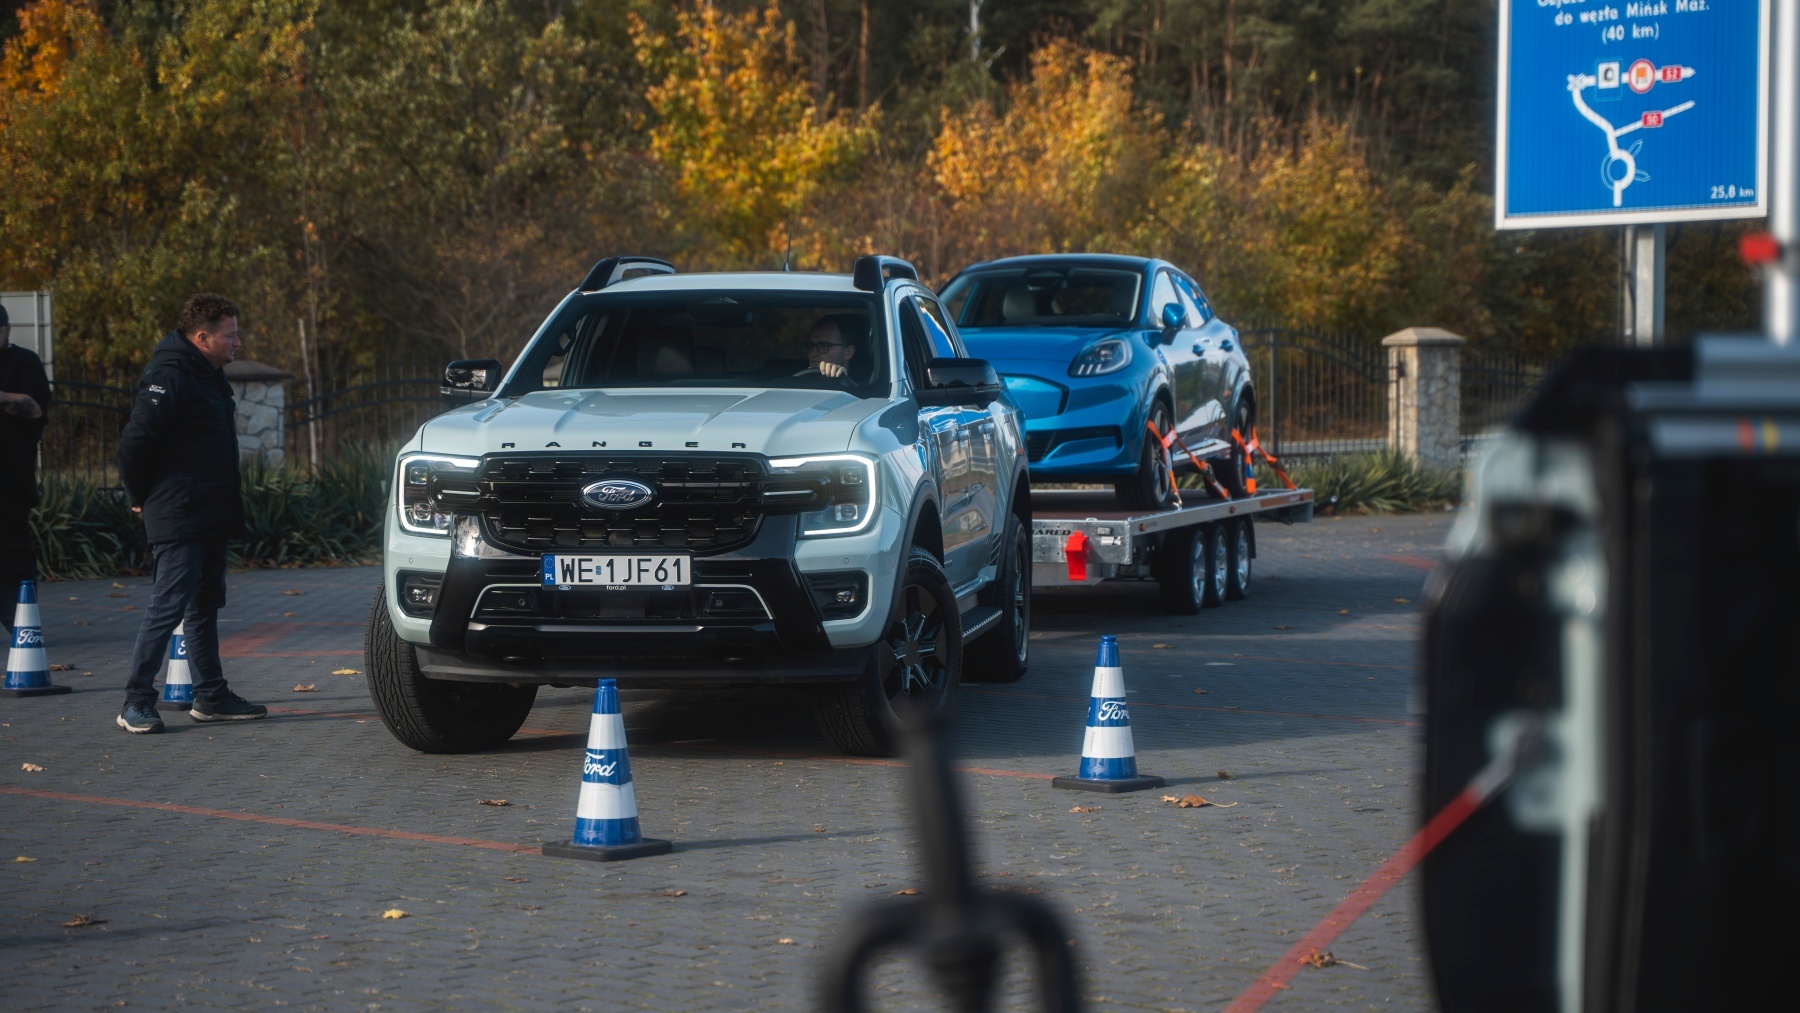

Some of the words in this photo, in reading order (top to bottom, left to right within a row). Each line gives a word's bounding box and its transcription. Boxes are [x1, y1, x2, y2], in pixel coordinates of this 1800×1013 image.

[1554, 9, 1573, 26] do
[1626, 0, 1668, 18] Mińsk
[1602, 24, 1625, 45] (40
[1632, 21, 1660, 41] km)
[1739, 186, 1755, 198] km
[149, 384, 166, 394] Ford
[501, 441, 746, 449] RANGER
[598, 486, 635, 501] Ford
[561, 558, 593, 583] WE
[606, 557, 682, 583] 1JF61
[545, 573, 555, 581] PL
